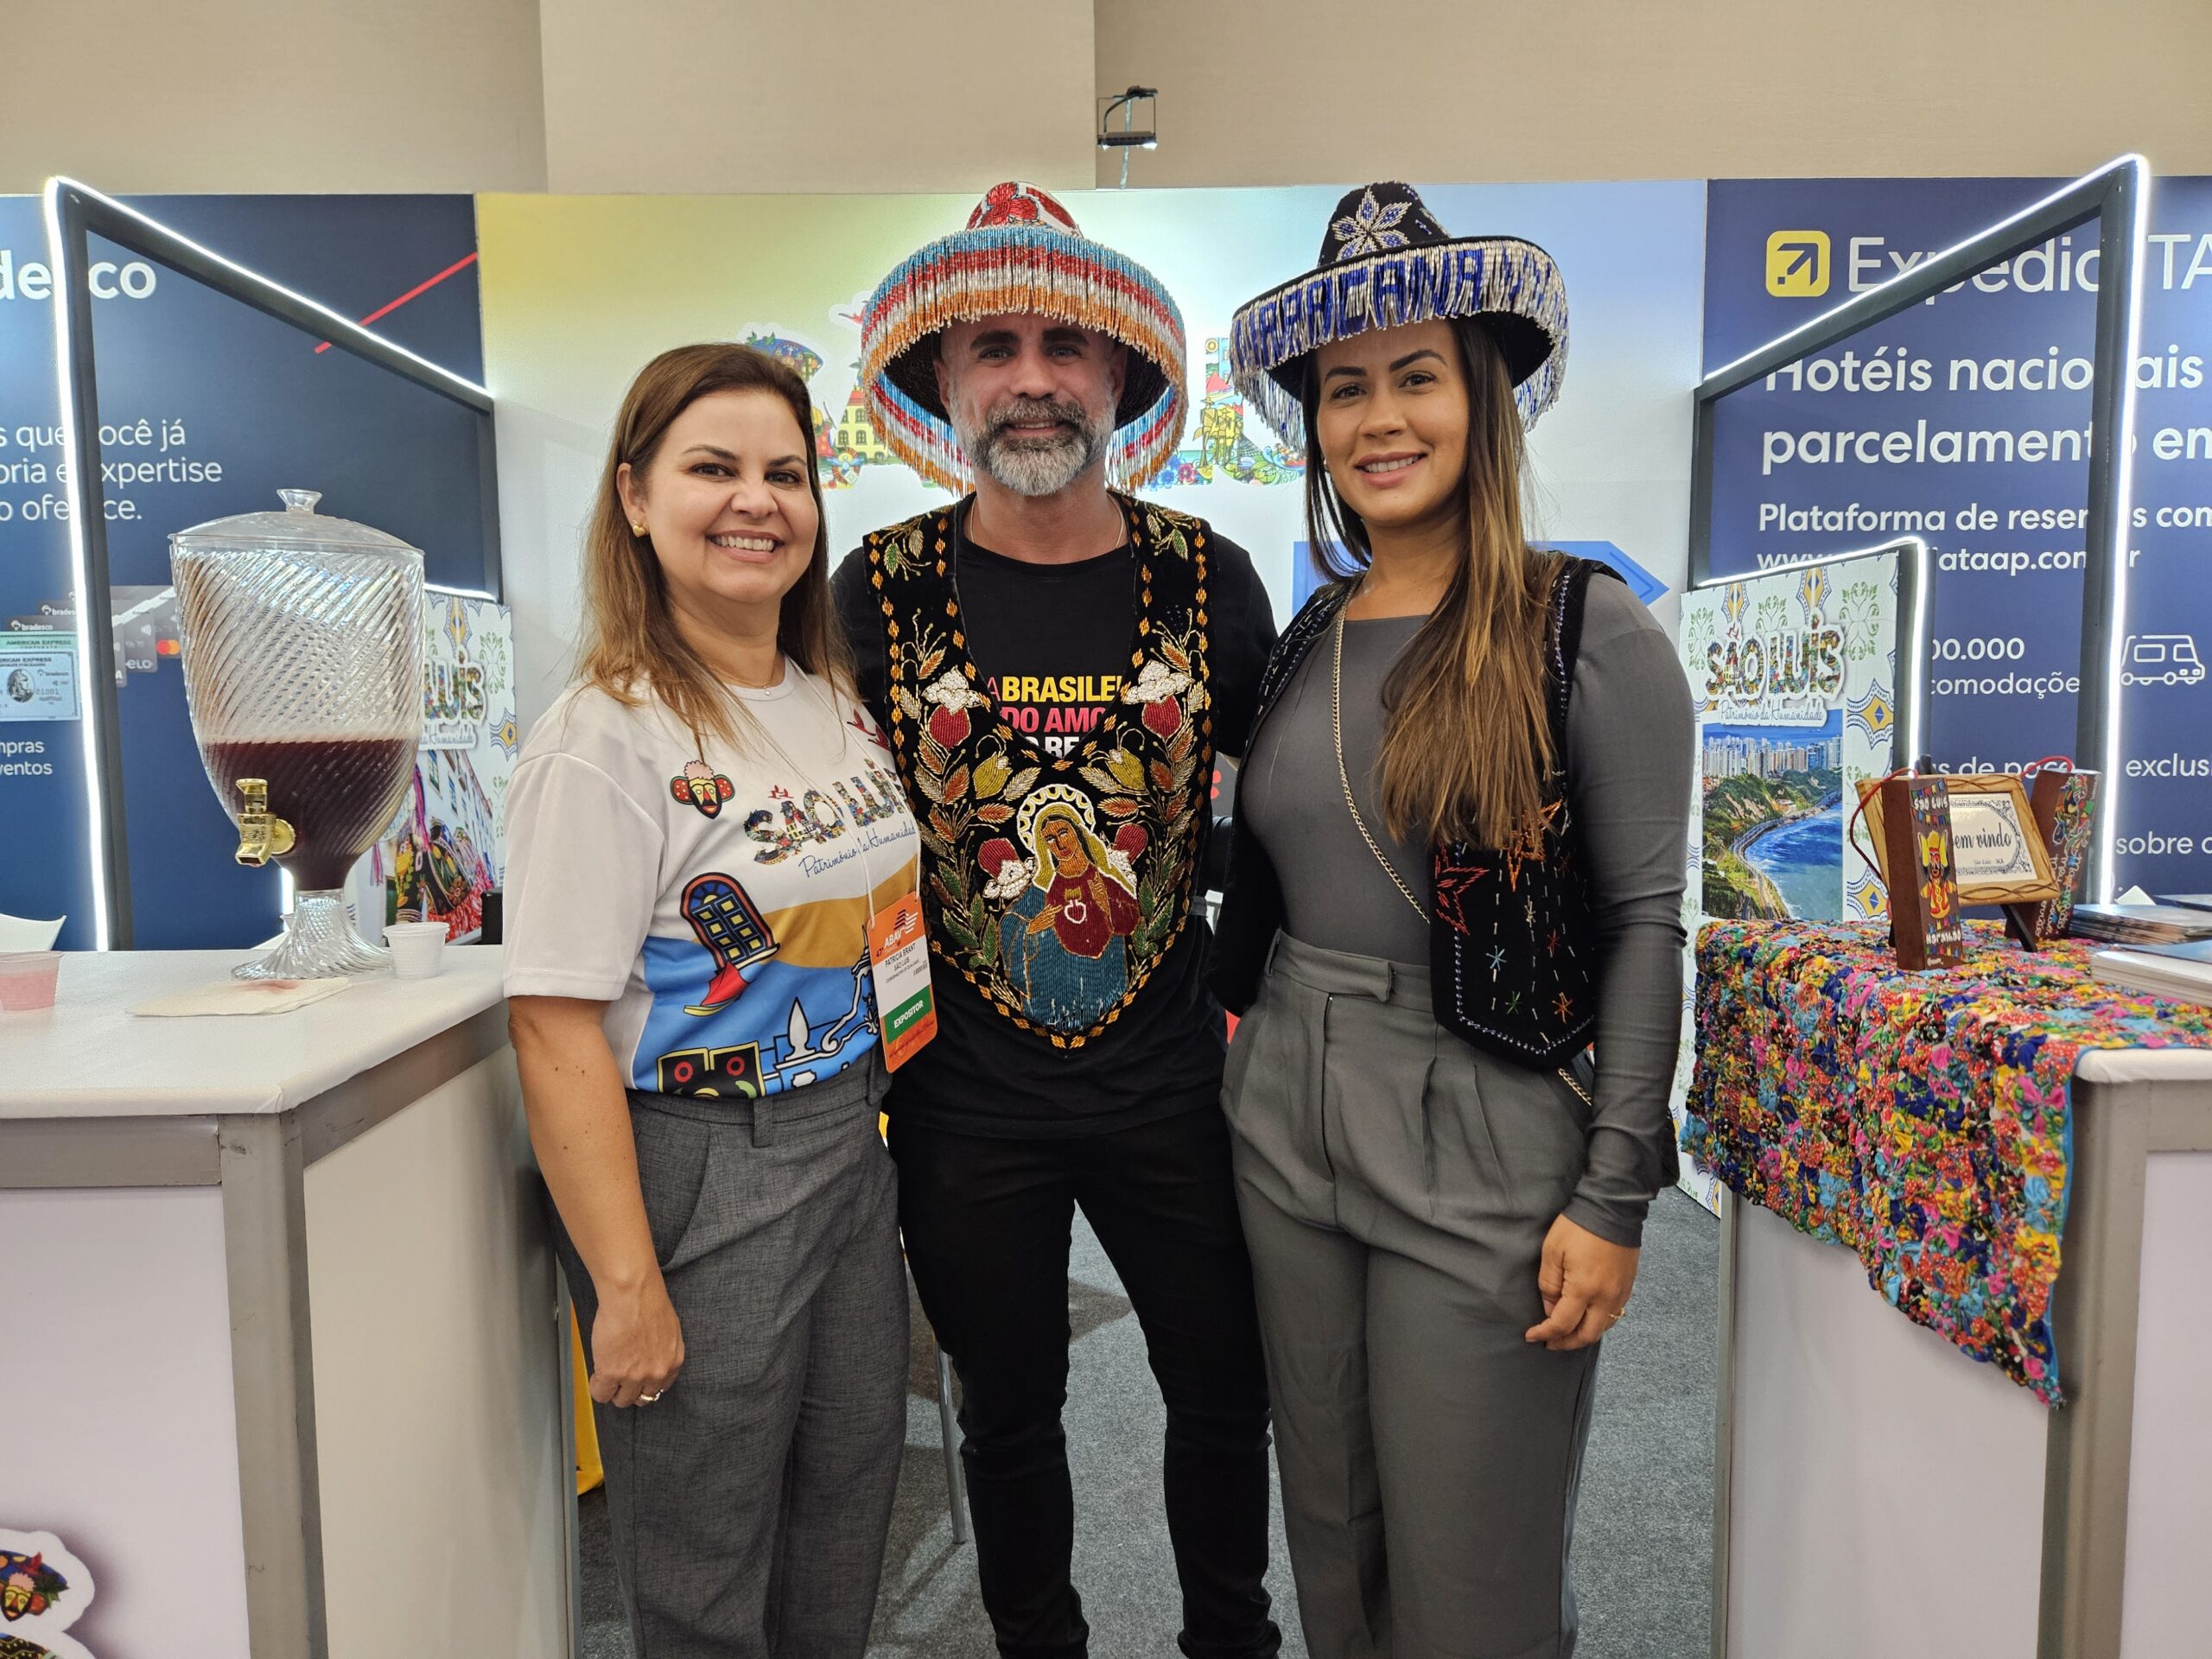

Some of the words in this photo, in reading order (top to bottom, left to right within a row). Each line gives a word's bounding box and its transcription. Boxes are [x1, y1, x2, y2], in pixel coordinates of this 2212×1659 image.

[0, 250, 157, 300] deco
[1948, 344, 2204, 391] nacioais
[99, 419, 153, 446] ocê
[160, 418, 187, 453] já
[100, 456, 223, 490] xpertise
[22, 493, 143, 521] ofece.
[1758, 502, 1946, 532] Plataforma
[1955, 502, 1999, 531] de
[2008, 506, 2148, 531] resers
[22, 623, 54, 632] bradesco
[1001, 675, 1123, 702] BRASILE
[1954, 833, 1974, 849] em
[2116, 830, 2194, 855] sobre
[893, 999, 924, 1028] EXPOSITOR
